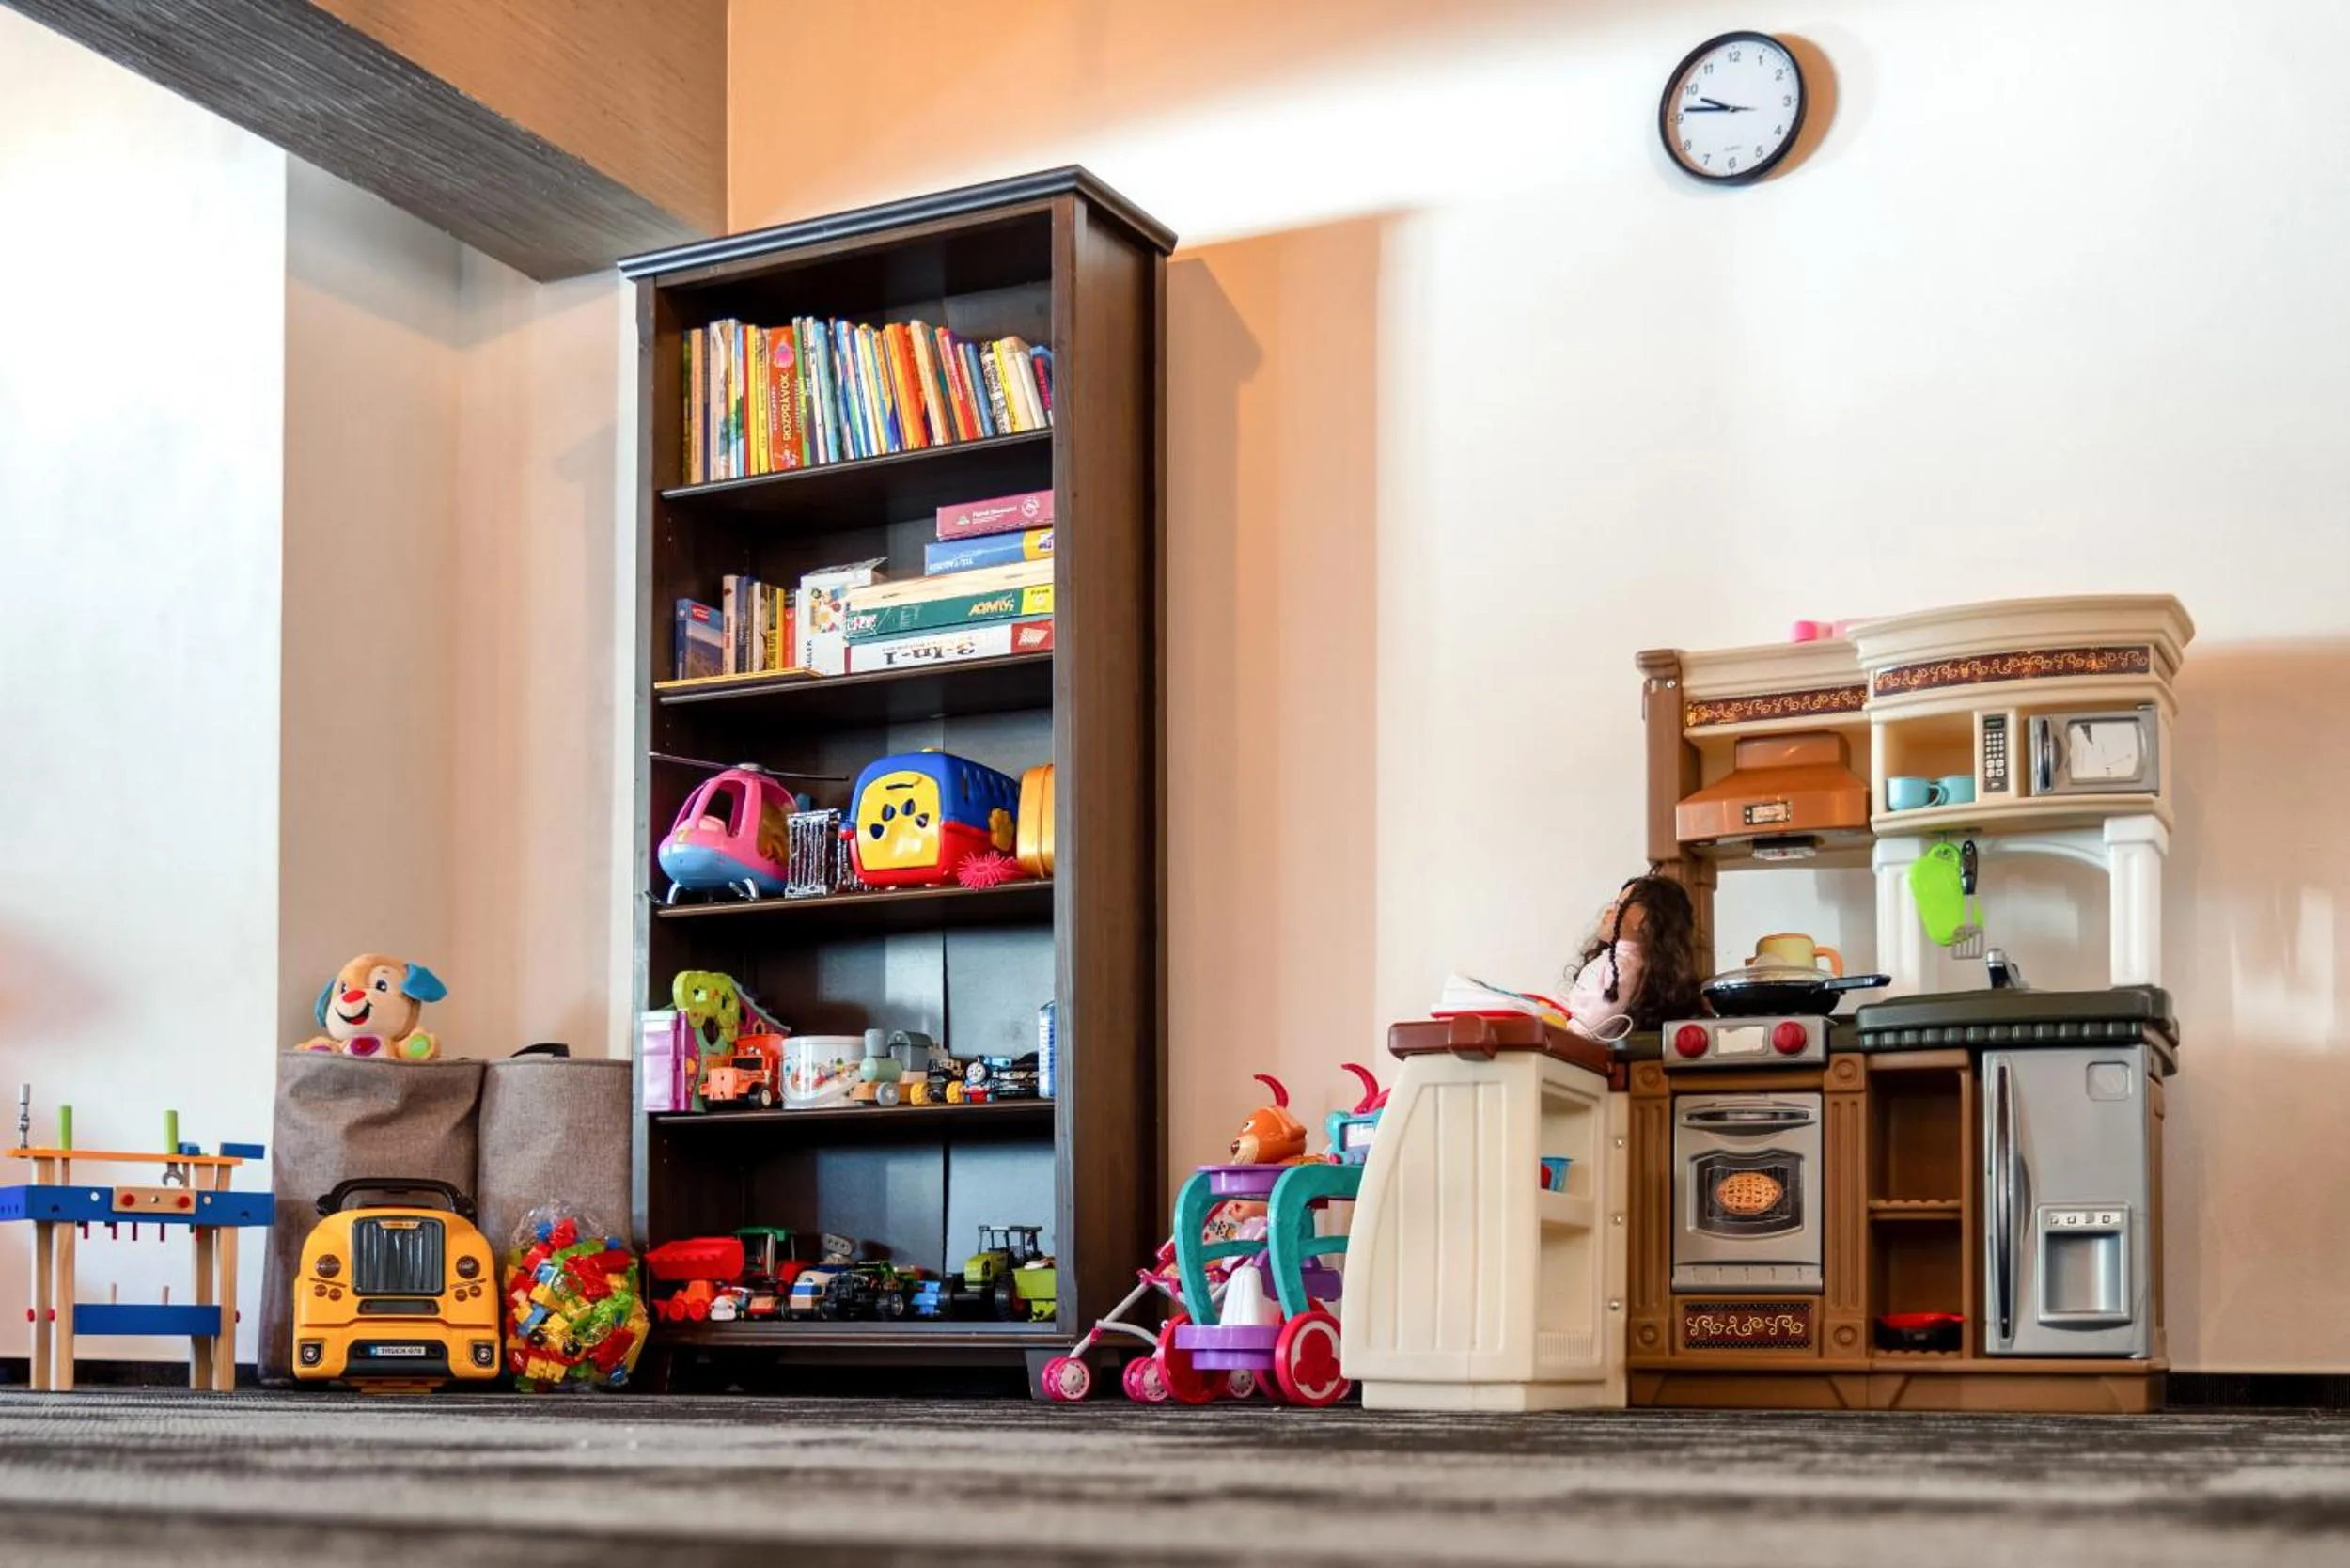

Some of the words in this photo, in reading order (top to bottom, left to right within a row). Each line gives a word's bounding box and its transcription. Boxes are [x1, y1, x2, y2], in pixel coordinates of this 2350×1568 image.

[1728, 51, 1740, 62] 12
[1703, 64, 1714, 74] 11
[1775, 69, 1783, 81] 2
[1685, 83, 1698, 95] 10
[1783, 95, 1791, 107] 3
[1676, 113, 1684, 124] 9
[1774, 124, 1782, 135] 4
[1684, 140, 1692, 151] 8
[1755, 146, 1763, 158] 5
[1702, 153, 1711, 165] 7
[1728, 156, 1736, 168] 6
